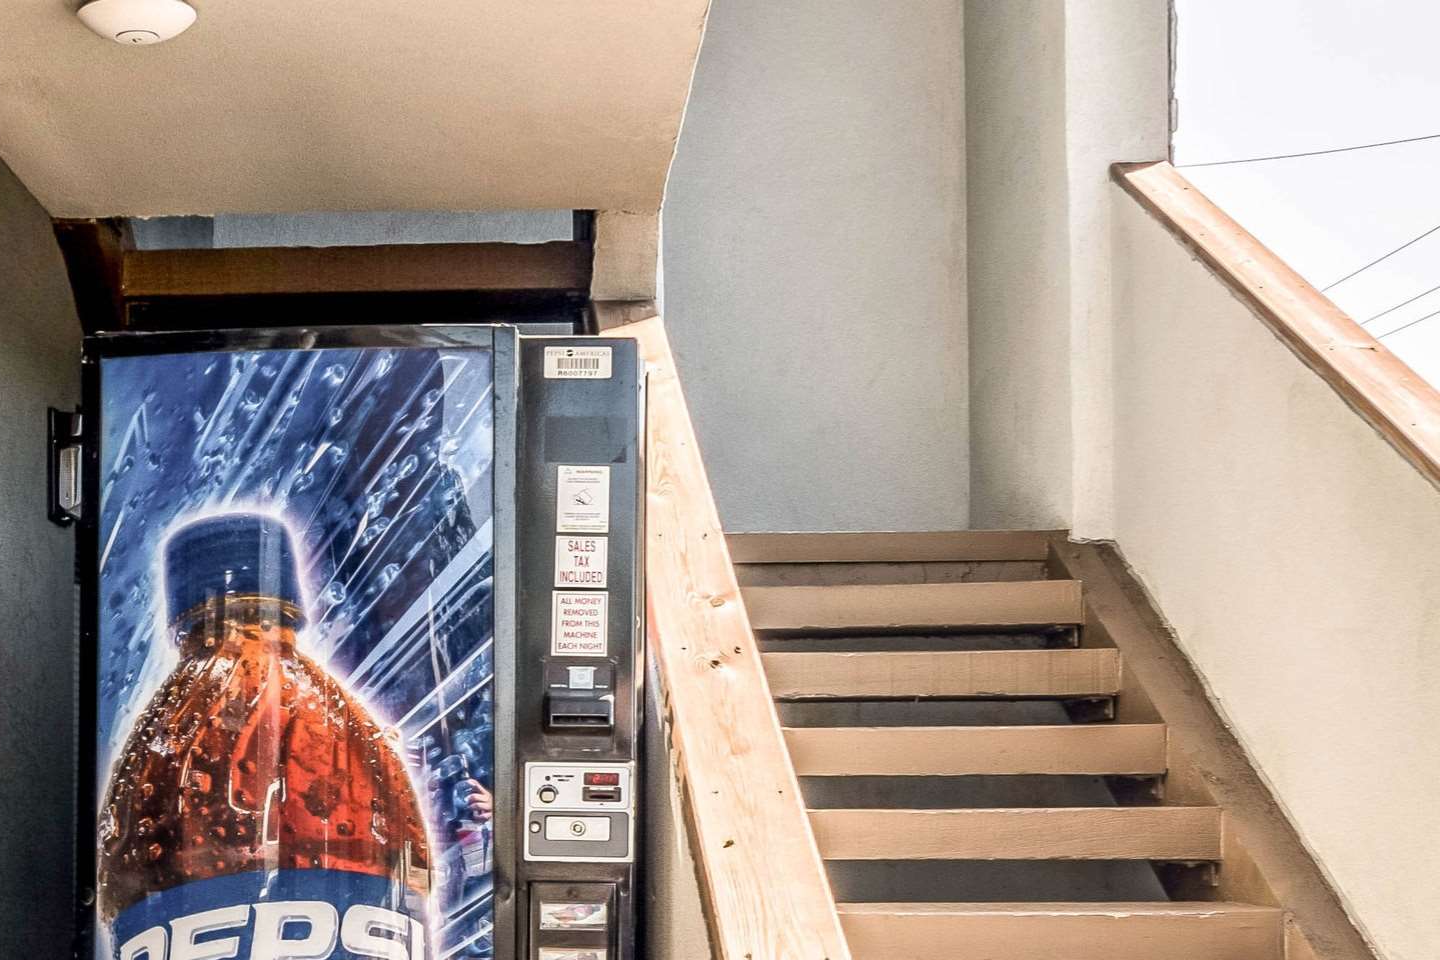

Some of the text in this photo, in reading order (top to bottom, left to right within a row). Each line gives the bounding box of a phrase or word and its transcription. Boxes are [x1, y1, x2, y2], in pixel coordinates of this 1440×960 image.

[567, 540, 596, 553] SALES
[574, 555, 590, 567] TAX
[559, 570, 603, 583] INCLUDED
[574, 597, 601, 605] MONEY
[563, 608, 599, 616] REMOVED
[561, 619, 583, 627] FROM
[563, 631, 598, 639] MACHINE
[558, 642, 577, 650] EACH
